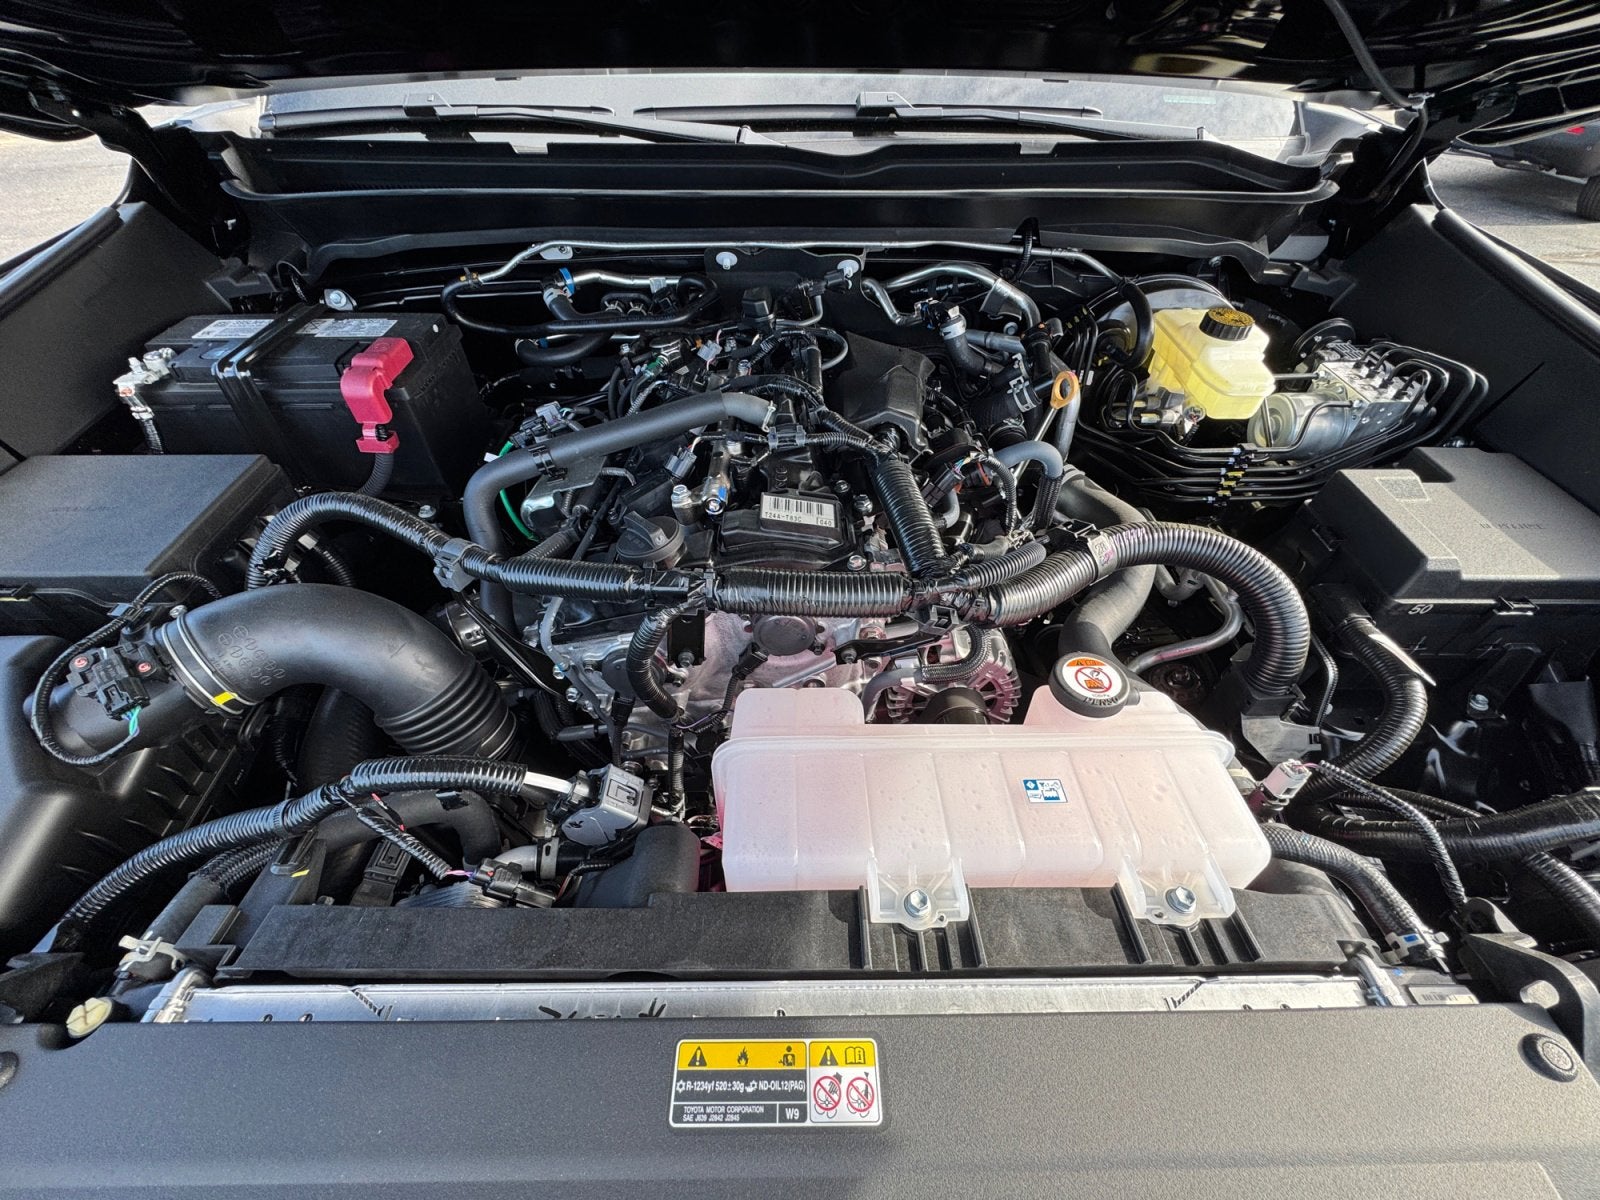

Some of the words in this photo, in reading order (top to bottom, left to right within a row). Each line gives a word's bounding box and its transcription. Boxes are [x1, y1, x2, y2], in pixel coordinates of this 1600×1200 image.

[1408, 603, 1434, 615] 50
[686, 1080, 715, 1094] R-1234yf
[715, 1080, 744, 1093] 520±30g
[758, 1079, 806, 1092] ND-OIL12(PAG)
[683, 1105, 704, 1114] TOYOTA
[705, 1105, 725, 1114] MOTOR
[726, 1105, 765, 1114] CORPORATION
[785, 1107, 800, 1120] W9
[682, 1114, 694, 1122] SAE
